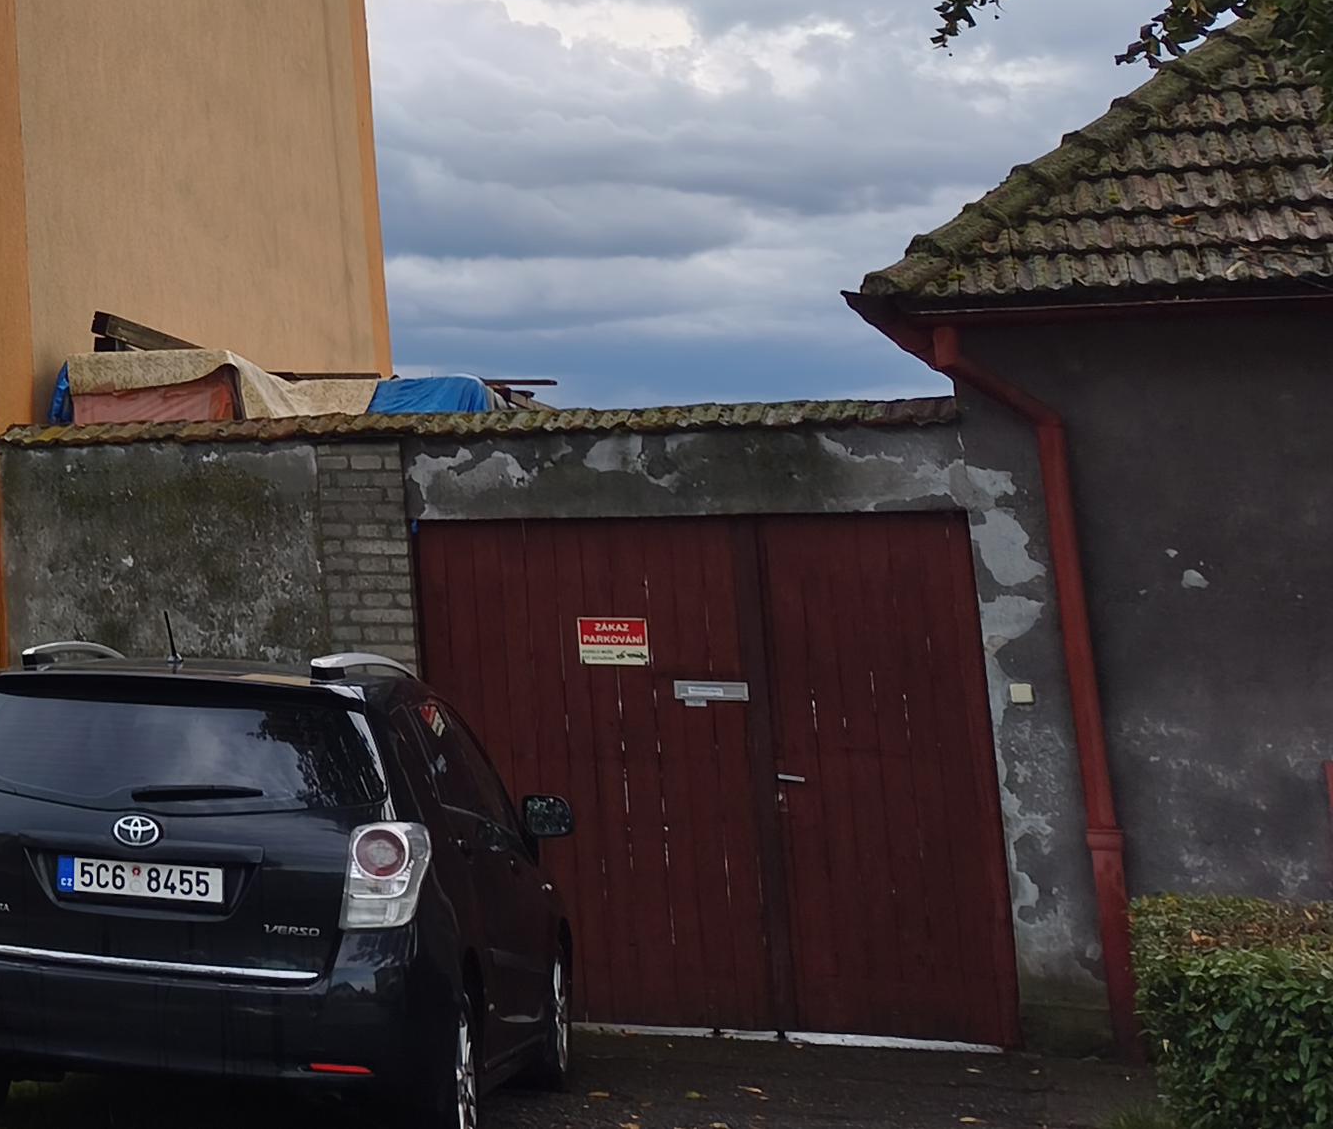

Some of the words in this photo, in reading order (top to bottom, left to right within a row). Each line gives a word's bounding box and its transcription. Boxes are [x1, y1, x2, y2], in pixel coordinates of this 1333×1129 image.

[594, 621, 629, 632] ZÁKAZ
[583, 633, 643, 644] PARKOVÁNÍ
[61, 877, 72, 887] CZ
[80, 862, 125, 890] 5C6
[147, 867, 209, 897] 8455
[263, 924, 320, 937] VERSO
